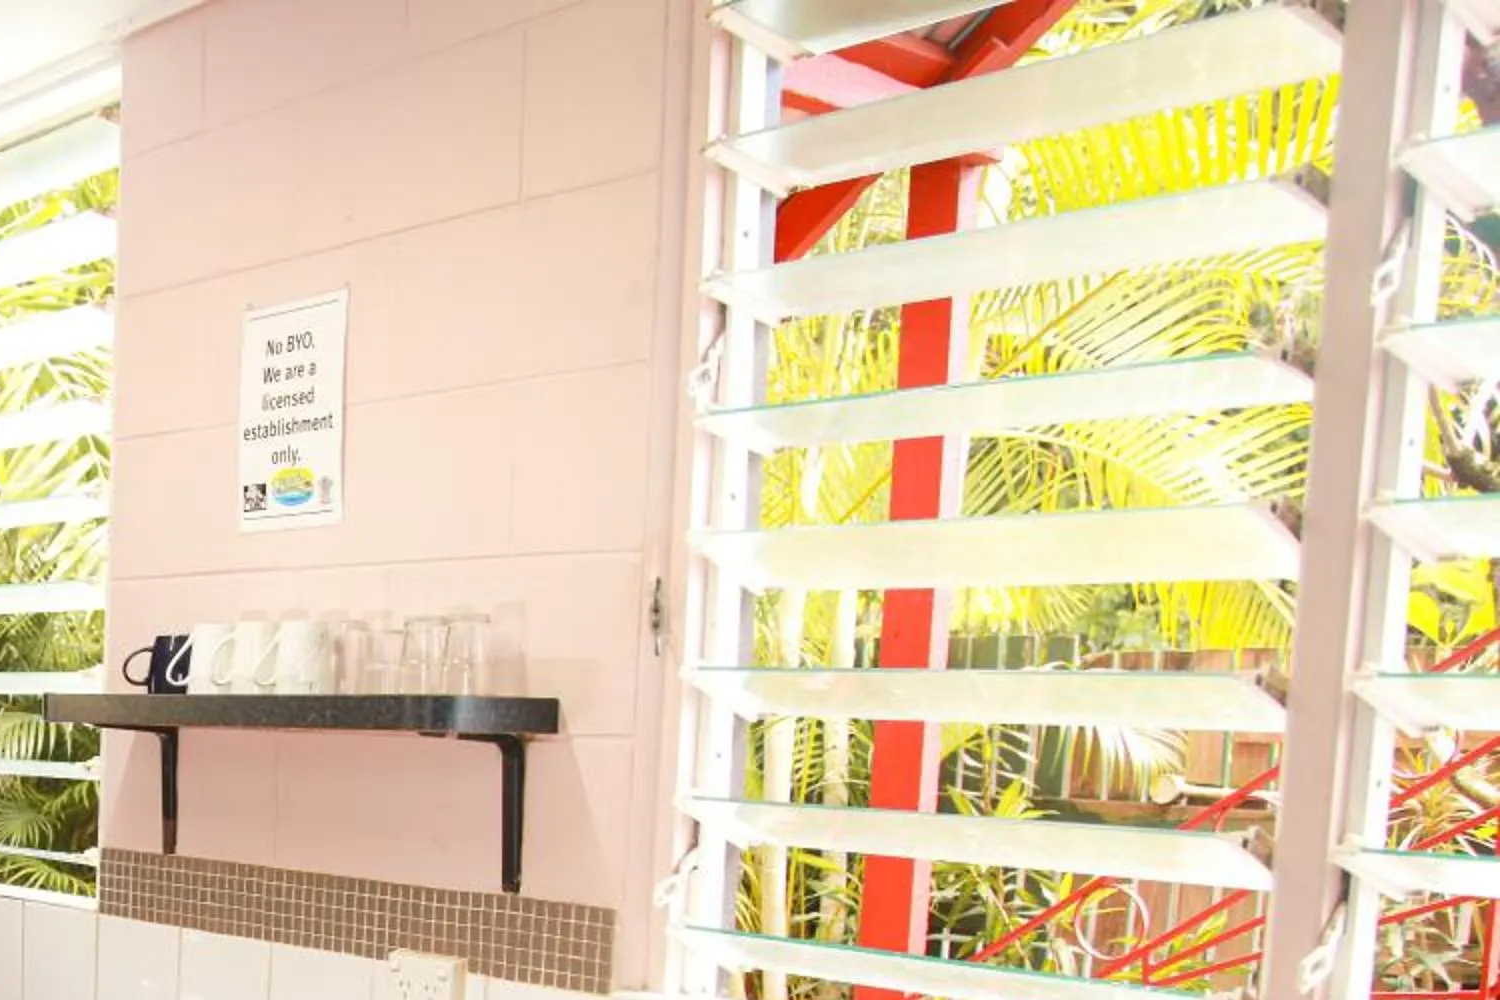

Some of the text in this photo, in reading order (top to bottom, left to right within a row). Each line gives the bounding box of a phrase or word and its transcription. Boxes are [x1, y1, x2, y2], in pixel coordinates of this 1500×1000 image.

[265, 331, 316, 357] No BYO.
[263, 362, 317, 384] We are a
[262, 385, 315, 410] licensed
[243, 413, 333, 440] establishment
[271, 444, 301, 466] only.
